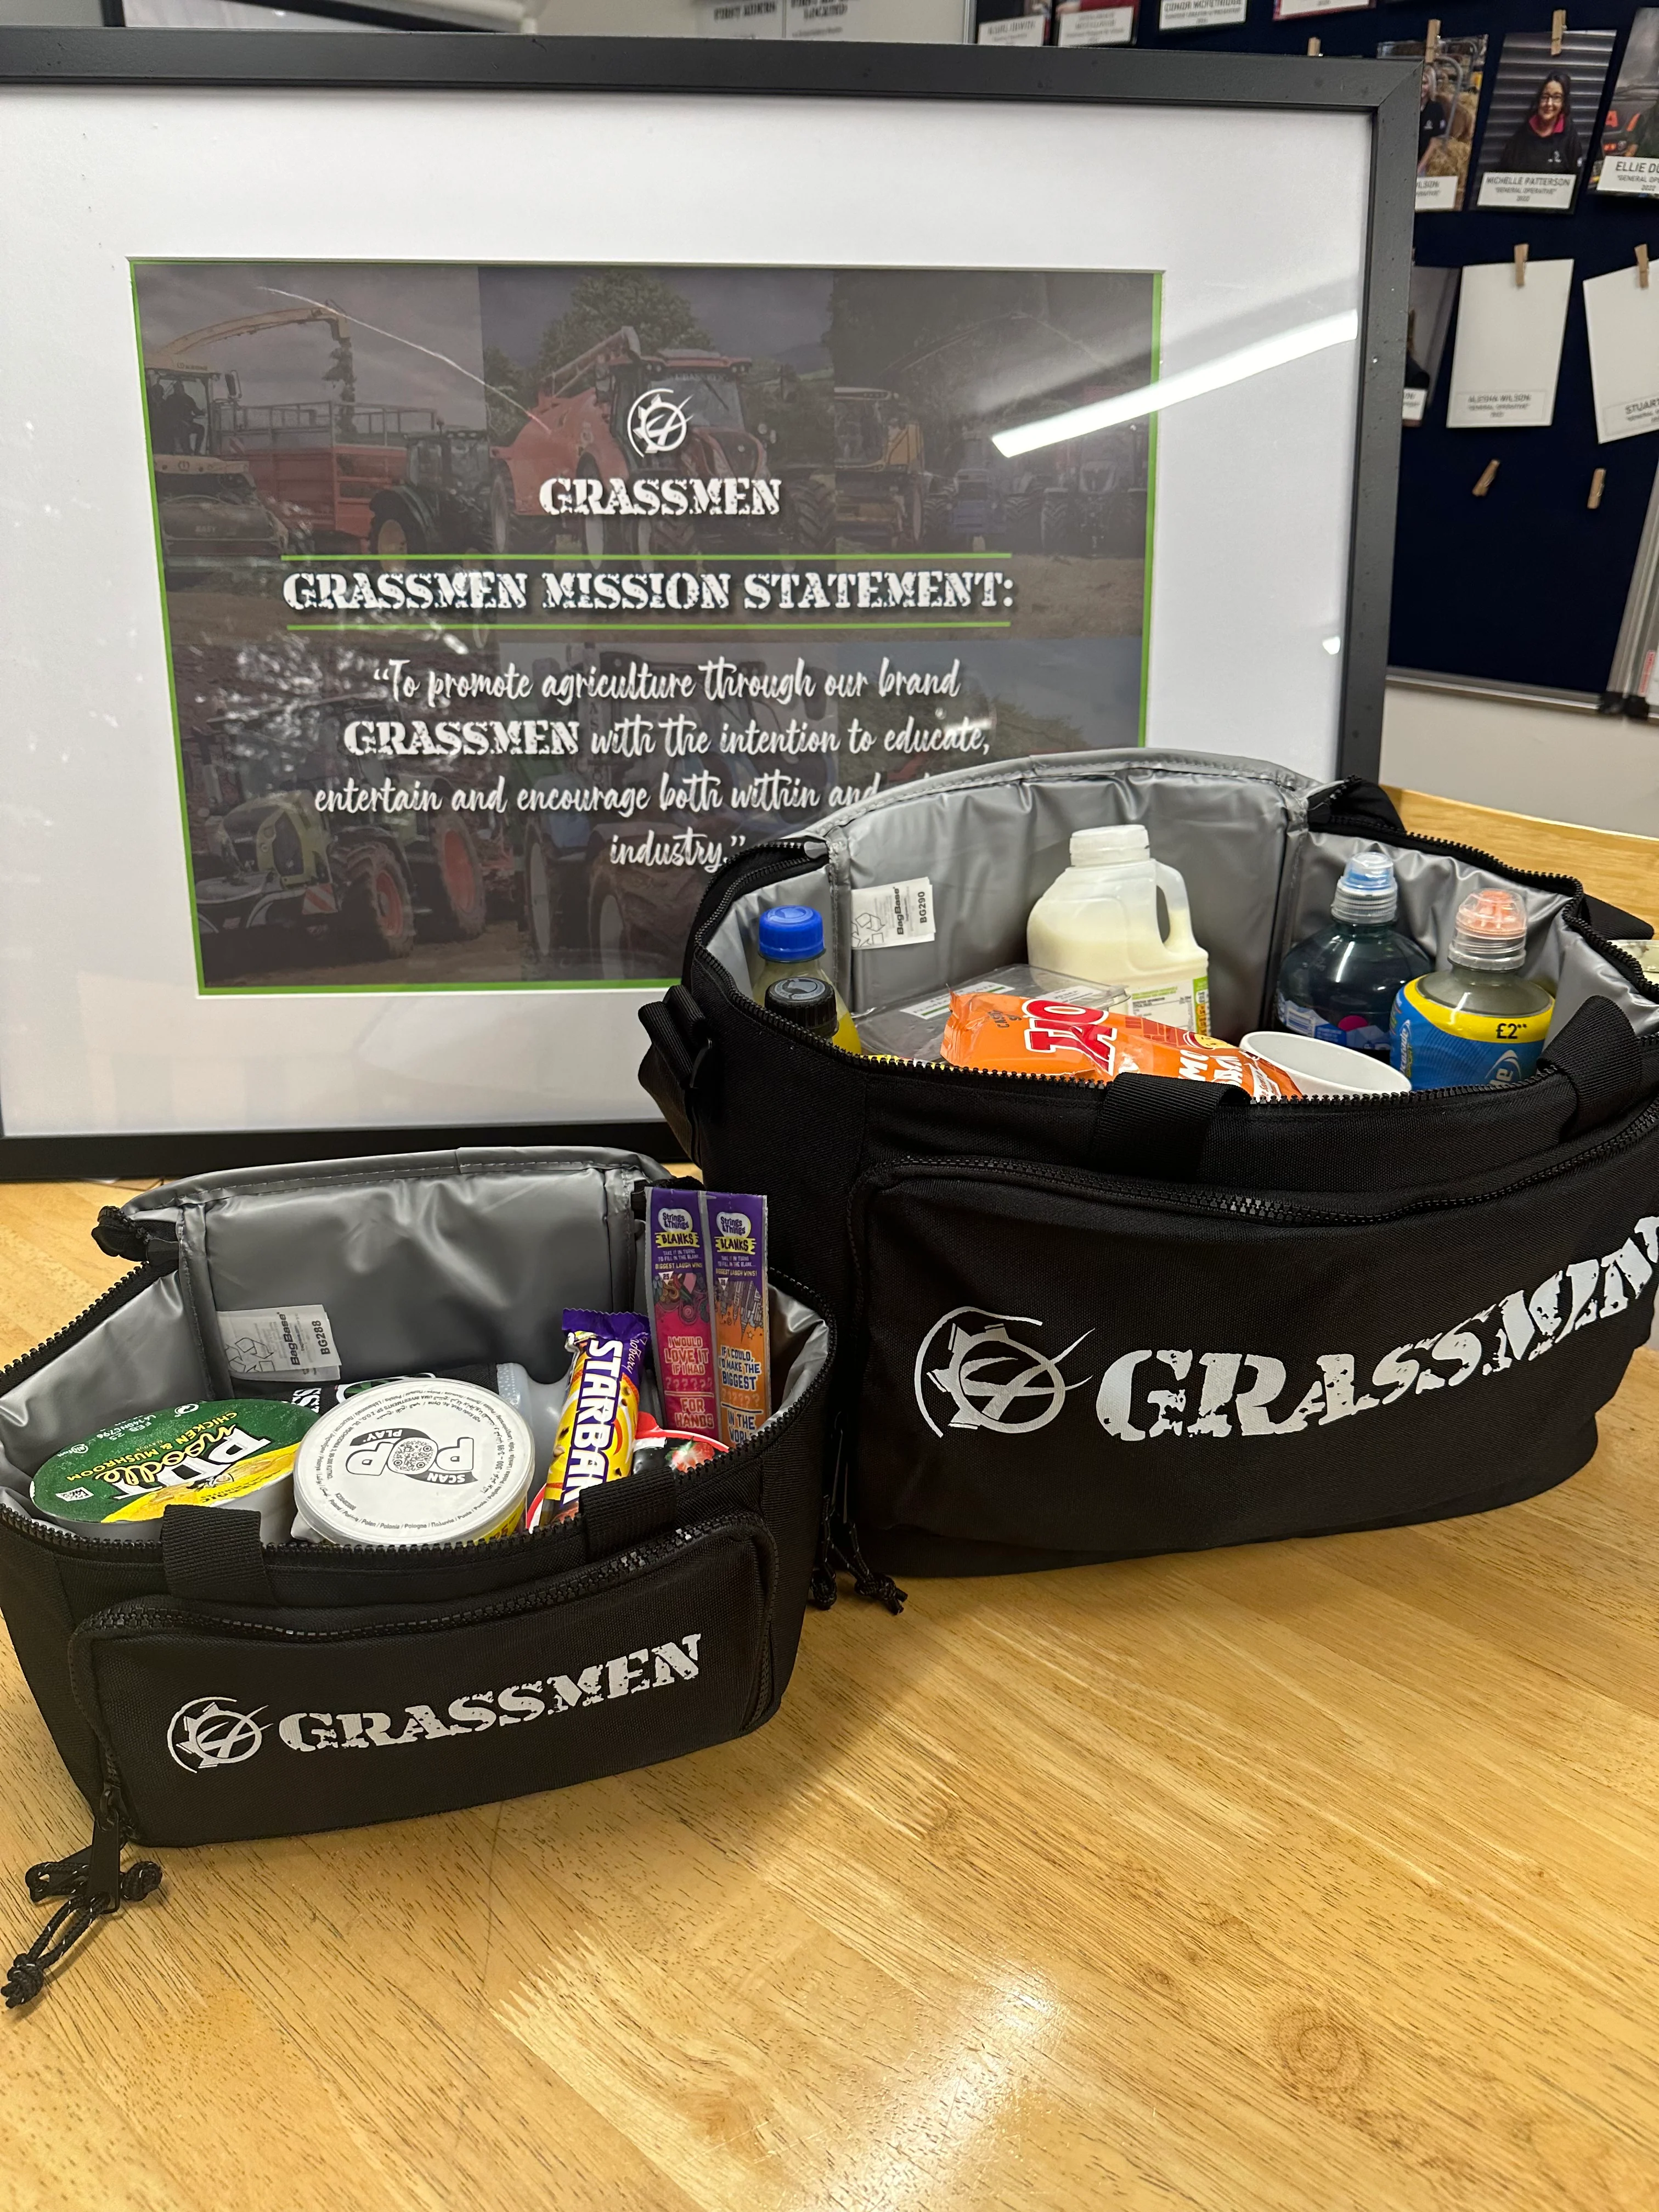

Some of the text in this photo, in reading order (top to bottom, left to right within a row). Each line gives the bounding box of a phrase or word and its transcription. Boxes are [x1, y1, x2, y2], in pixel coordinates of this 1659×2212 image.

[1615, 161, 1646, 172] ELLIE
[539, 477, 782, 516] GRASSMEN
[283, 571, 1014, 610] GRASSMEN MISSION STATEMENT:
[427, 663, 533, 708] promote
[541, 661, 696, 706] agriculture
[698, 656, 816, 705] through
[823, 669, 870, 698] our
[878, 657, 961, 698] brand
[343, 720, 580, 756] GRASSMEN
[590, 714, 657, 758] with
[658, 714, 713, 758] the
[720, 719, 840, 755] intention
[848, 718, 877, 754] to
[883, 715, 990, 756] educate,
[314, 768, 881, 818] entertain and encourage both within and
[918, 891, 927, 923] BG290
[663, 1212, 685, 1222] Strings
[720, 1216, 742, 1226] Strings
[661, 1233, 694, 1245] BLANKS
[720, 1239, 749, 1251] BLANKS
[312, 1320, 330, 1355] BG288
[1096, 1216, 1659, 1441] GRASSMEN
[279, 1314, 301, 1365] BagBase
[668, 1336, 703, 1347] I WOULD
[664, 1348, 709, 1364] LOVE IT
[721, 1346, 727, 1356] IF
[731, 1348, 755, 1362] COULD,
[672, 1363, 706, 1375] IF I HAD
[726, 1360, 742, 1372] MAKE
[744, 1363, 760, 1374] THE
[723, 1372, 757, 1390] BIGGEST
[383, 1396, 420, 1410] INVESTMENTS
[680, 1398, 705, 1413] FOR
[176, 1411, 238, 1444] CHICKEN
[675, 1413, 714, 1429] HANDS
[728, 1410, 755, 1430] IN THE
[109, 1420, 152, 1441] FEB 25
[93, 1424, 235, 1486] noodle
[160, 1442, 173, 1451] &
[66, 1449, 159, 1481] MUSHROOM
[426, 1472, 465, 1483] SCAN
[278, 1633, 702, 1752] GRASSMEN
